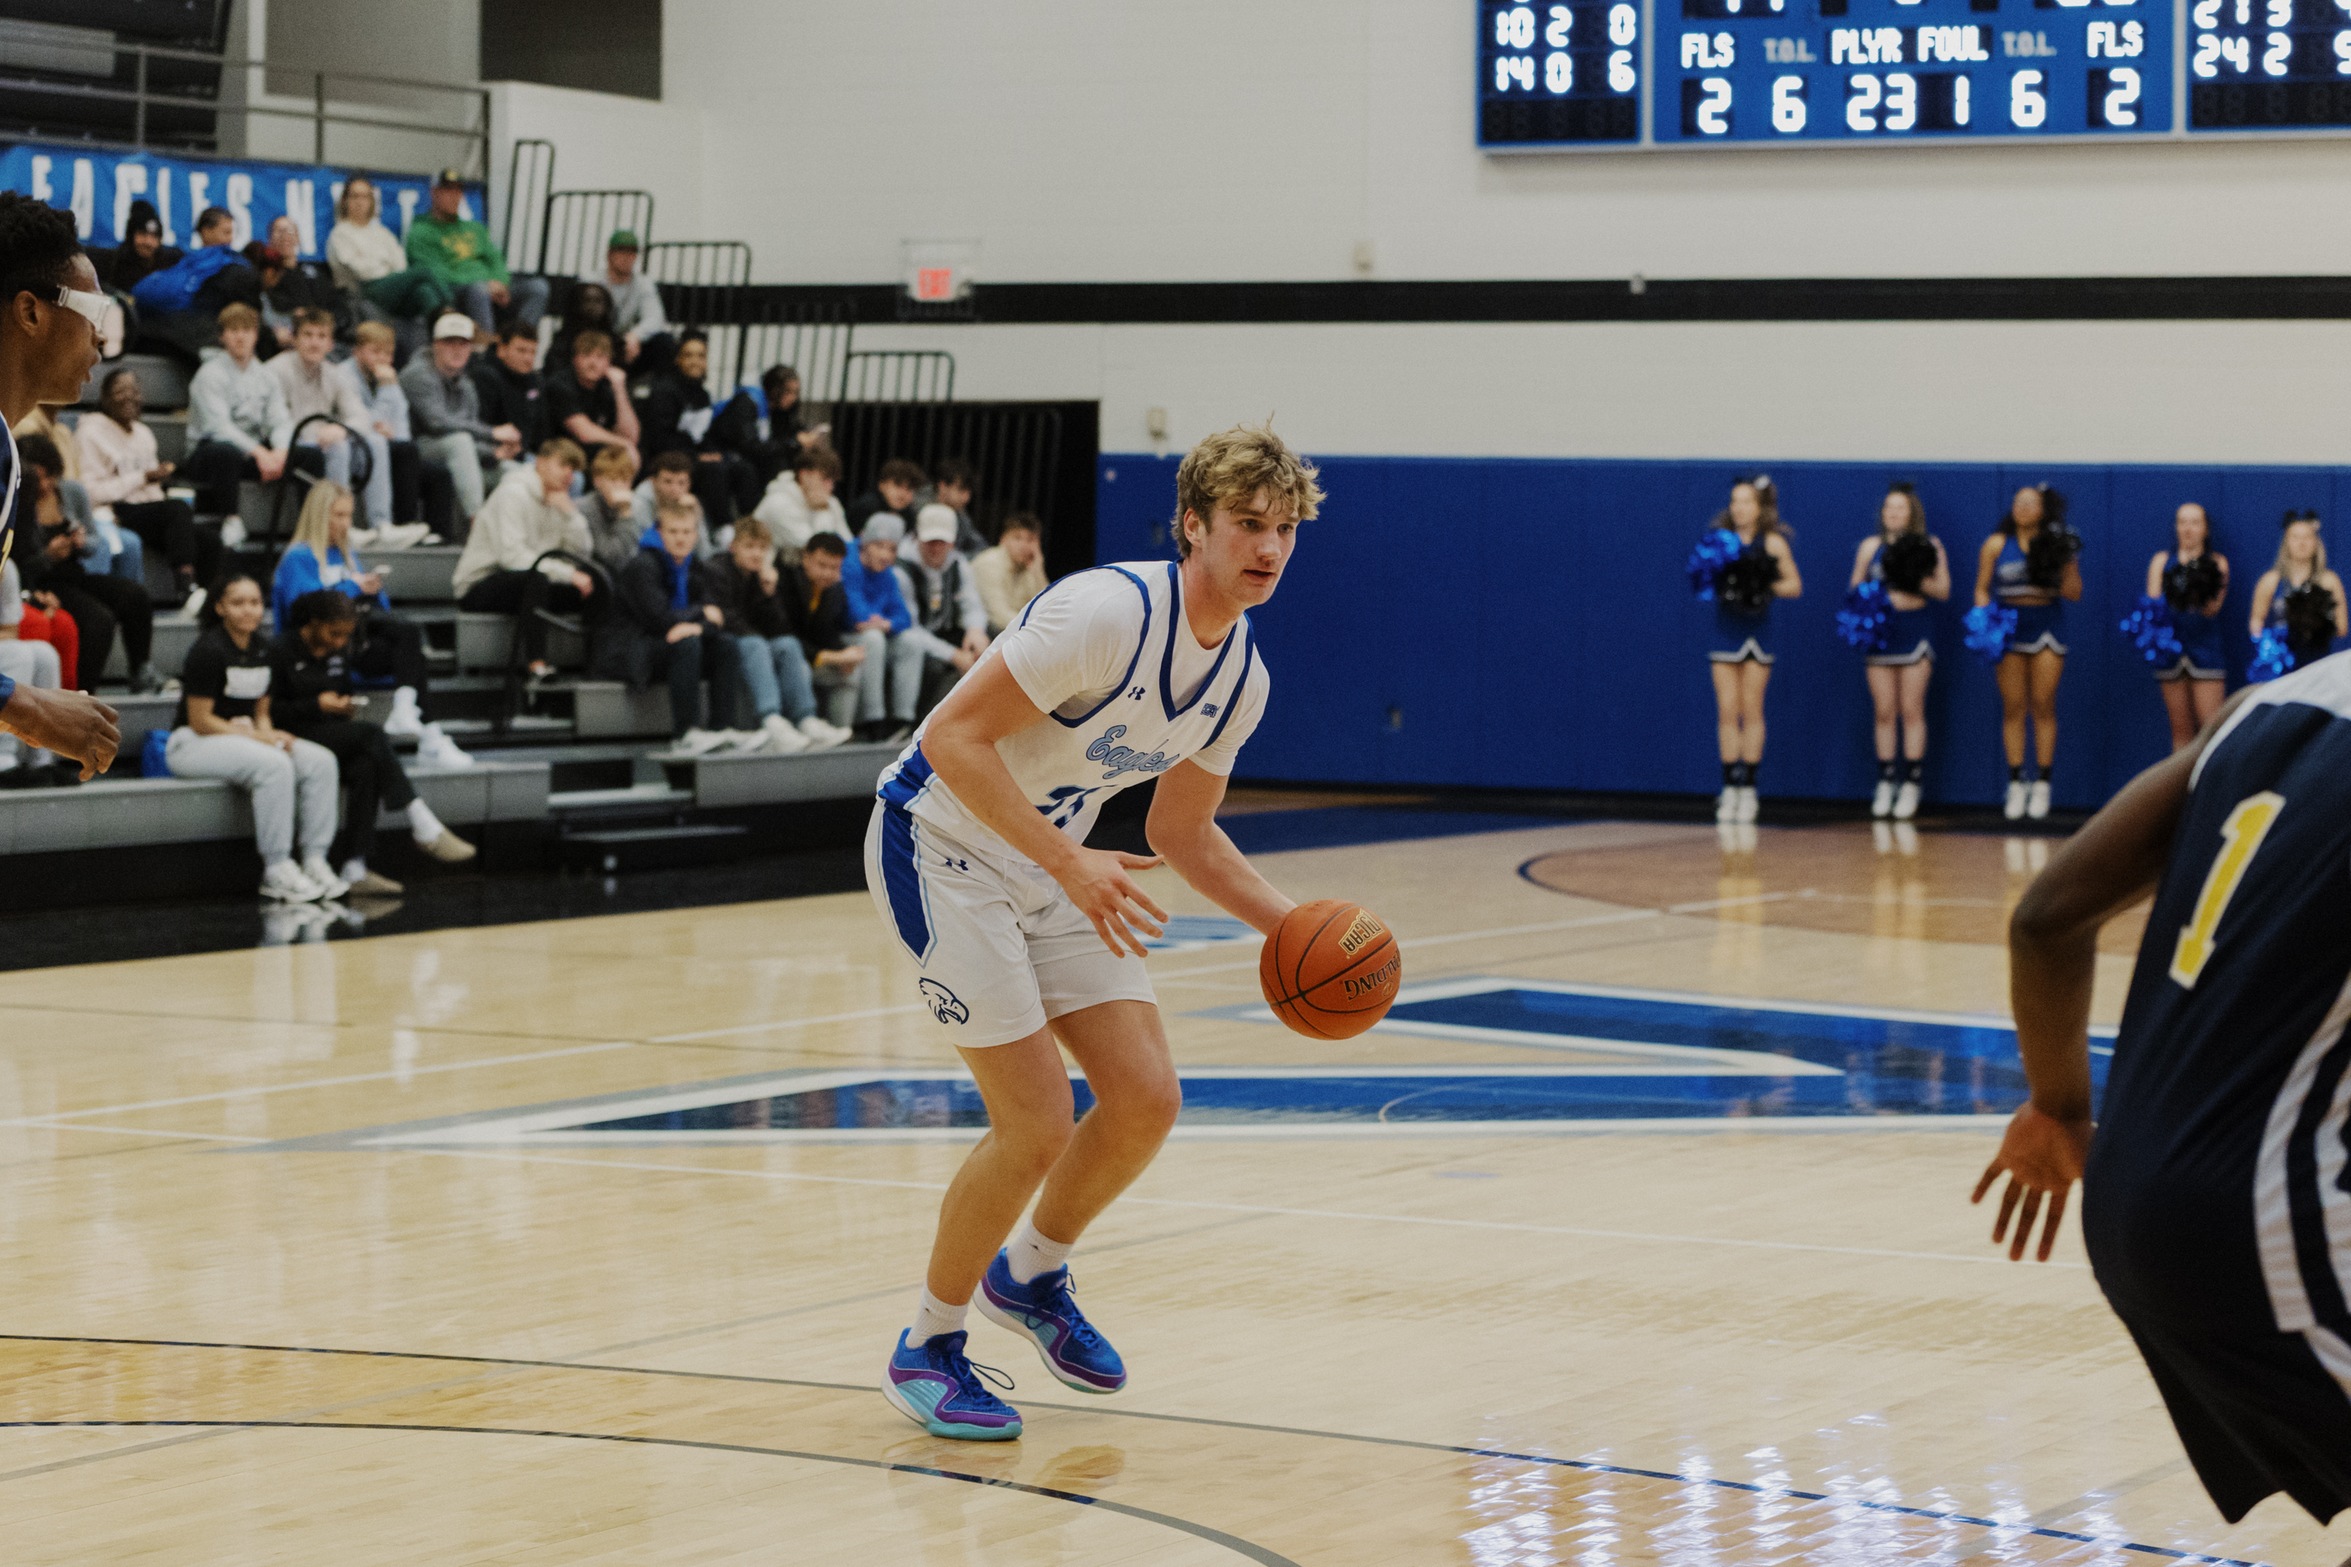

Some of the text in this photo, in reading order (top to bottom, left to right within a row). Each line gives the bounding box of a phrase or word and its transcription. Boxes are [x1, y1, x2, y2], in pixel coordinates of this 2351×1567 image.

[1546, 6, 1573, 48] 2
[1609, 3, 1636, 46] 0
[1681, 32, 1735, 68] FLS
[1832, 25, 1989, 65] PLYR FOUL
[2087, 20, 2143, 58] FLS
[1496, 50, 1635, 94] 14 0 6
[2193, 32, 2249, 78] 24
[2263, 32, 2292, 76] 2
[1698, 77, 1732, 134] 2
[1772, 75, 1806, 132] 6
[1846, 73, 1916, 131] 23
[1955, 75, 1970, 125] 1
[2011, 70, 2046, 127] 6
[2105, 67, 2140, 126] 2
[31, 154, 254, 252] EAGLES
[2169, 790, 2287, 990] 1
[1341, 911, 1383, 952] NJCAA
[1343, 947, 1401, 1001] PALDING
